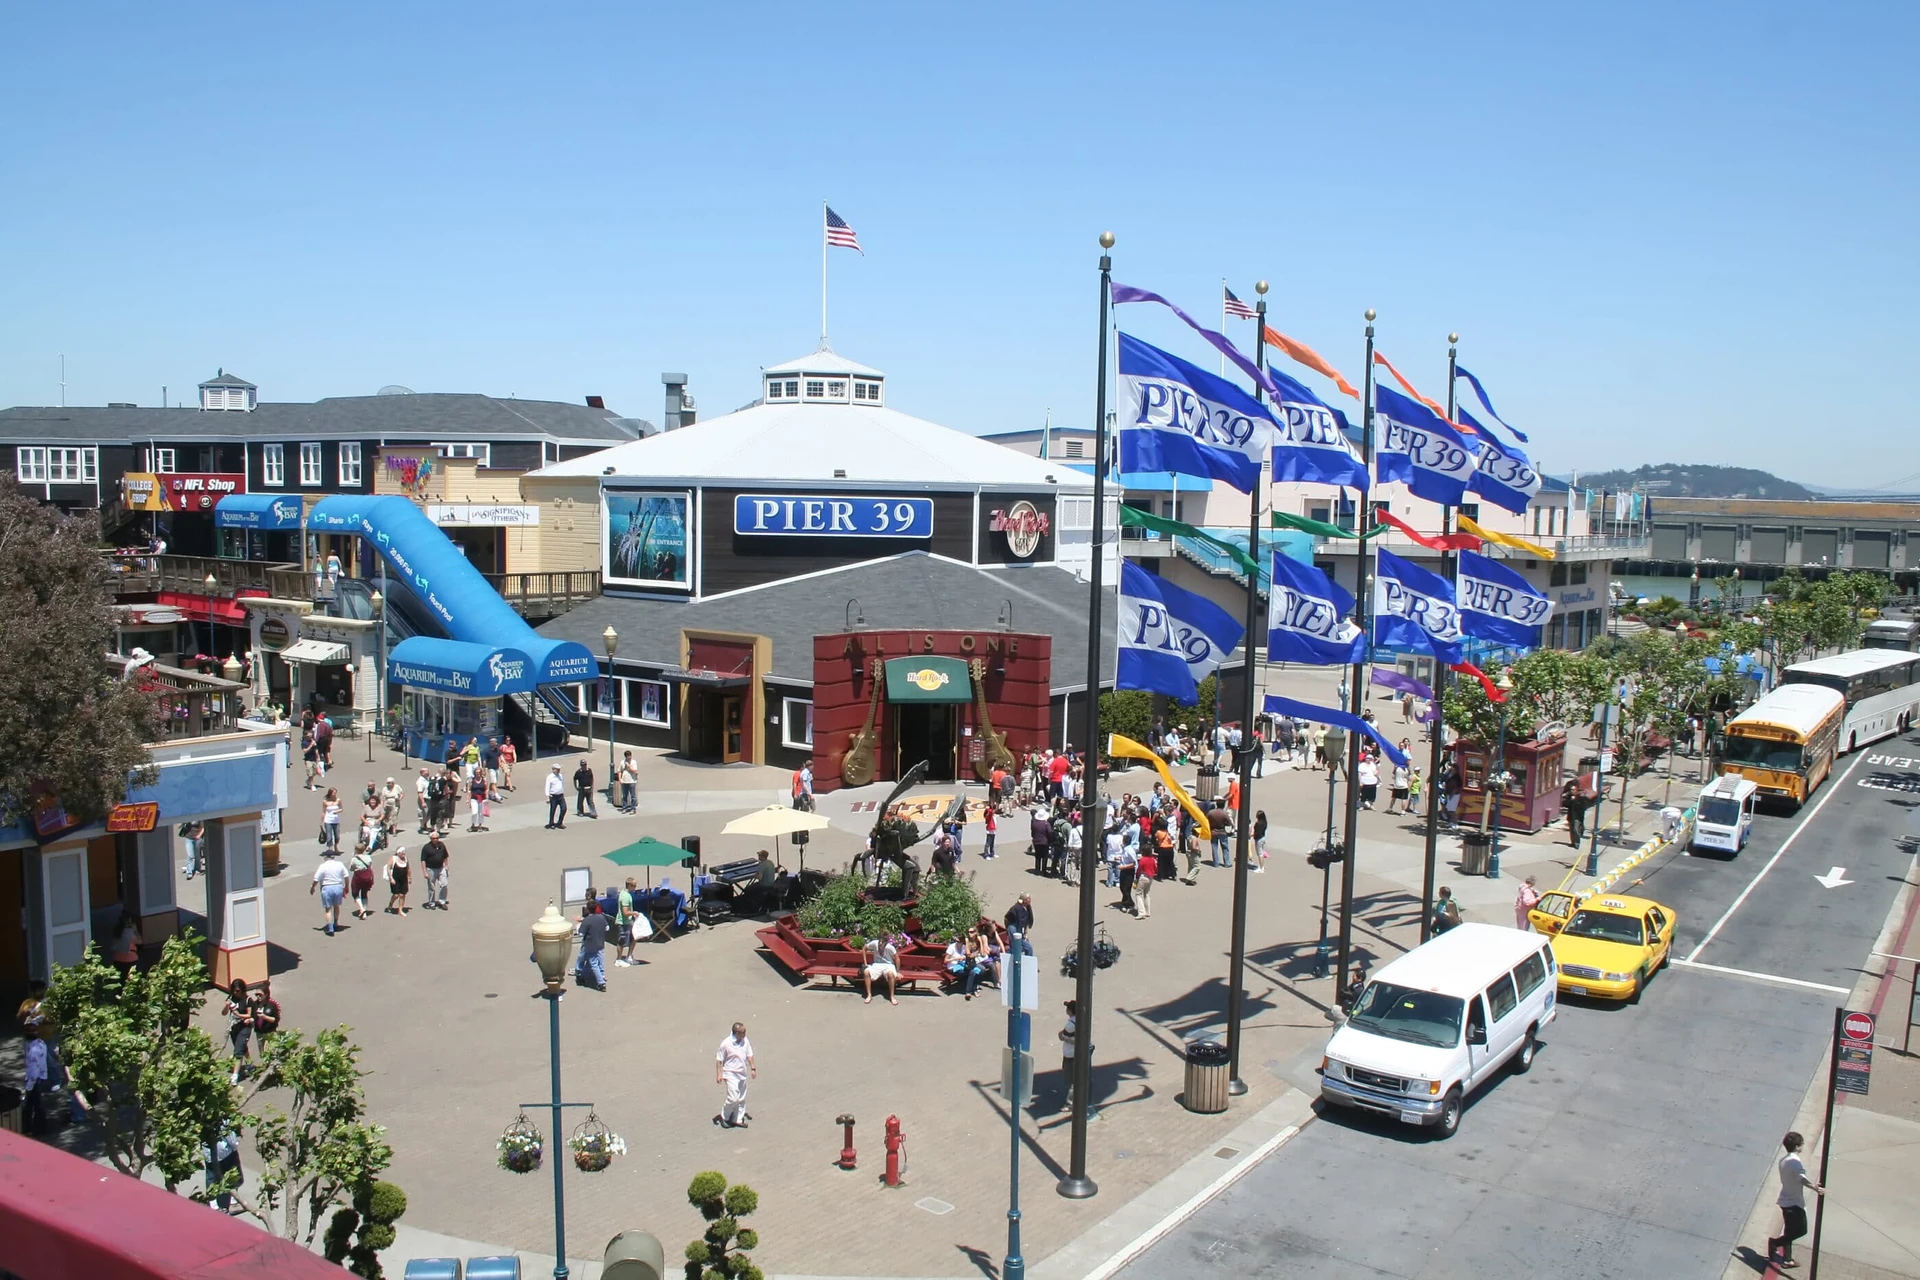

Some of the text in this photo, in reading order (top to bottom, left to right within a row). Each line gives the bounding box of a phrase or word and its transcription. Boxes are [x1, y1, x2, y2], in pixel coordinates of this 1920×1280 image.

[1136, 382, 1255, 448] PIER 39
[1424, 440, 1467, 472] 39
[1497, 459, 1536, 489] 39
[184, 479, 205, 491] NFL
[207, 479, 235, 493] Shop
[131, 493, 147, 504] SHOP
[284, 511, 298, 519] BAY
[753, 499, 915, 532] PIER 39
[361, 519, 373, 533] Rays
[1024, 511, 1049, 537] Rock
[402, 561, 414, 577] Fish
[428, 592, 454, 622] Touch Pool
[1464, 579, 1548, 623] PIER 39
[844, 634, 1018, 653] ALL IS ONE
[549, 658, 588, 668] AQUARIUM
[394, 662, 436, 684] AQUARIUM
[453, 671, 471, 689] BAY
[504, 669, 523, 680] BAY
[550, 667, 588, 677] ENTRANCE
[908, 673, 949, 683] Hard Rock
[1866, 753, 1920, 769] LEAR
[1844, 1040, 1869, 1049] streetcar
